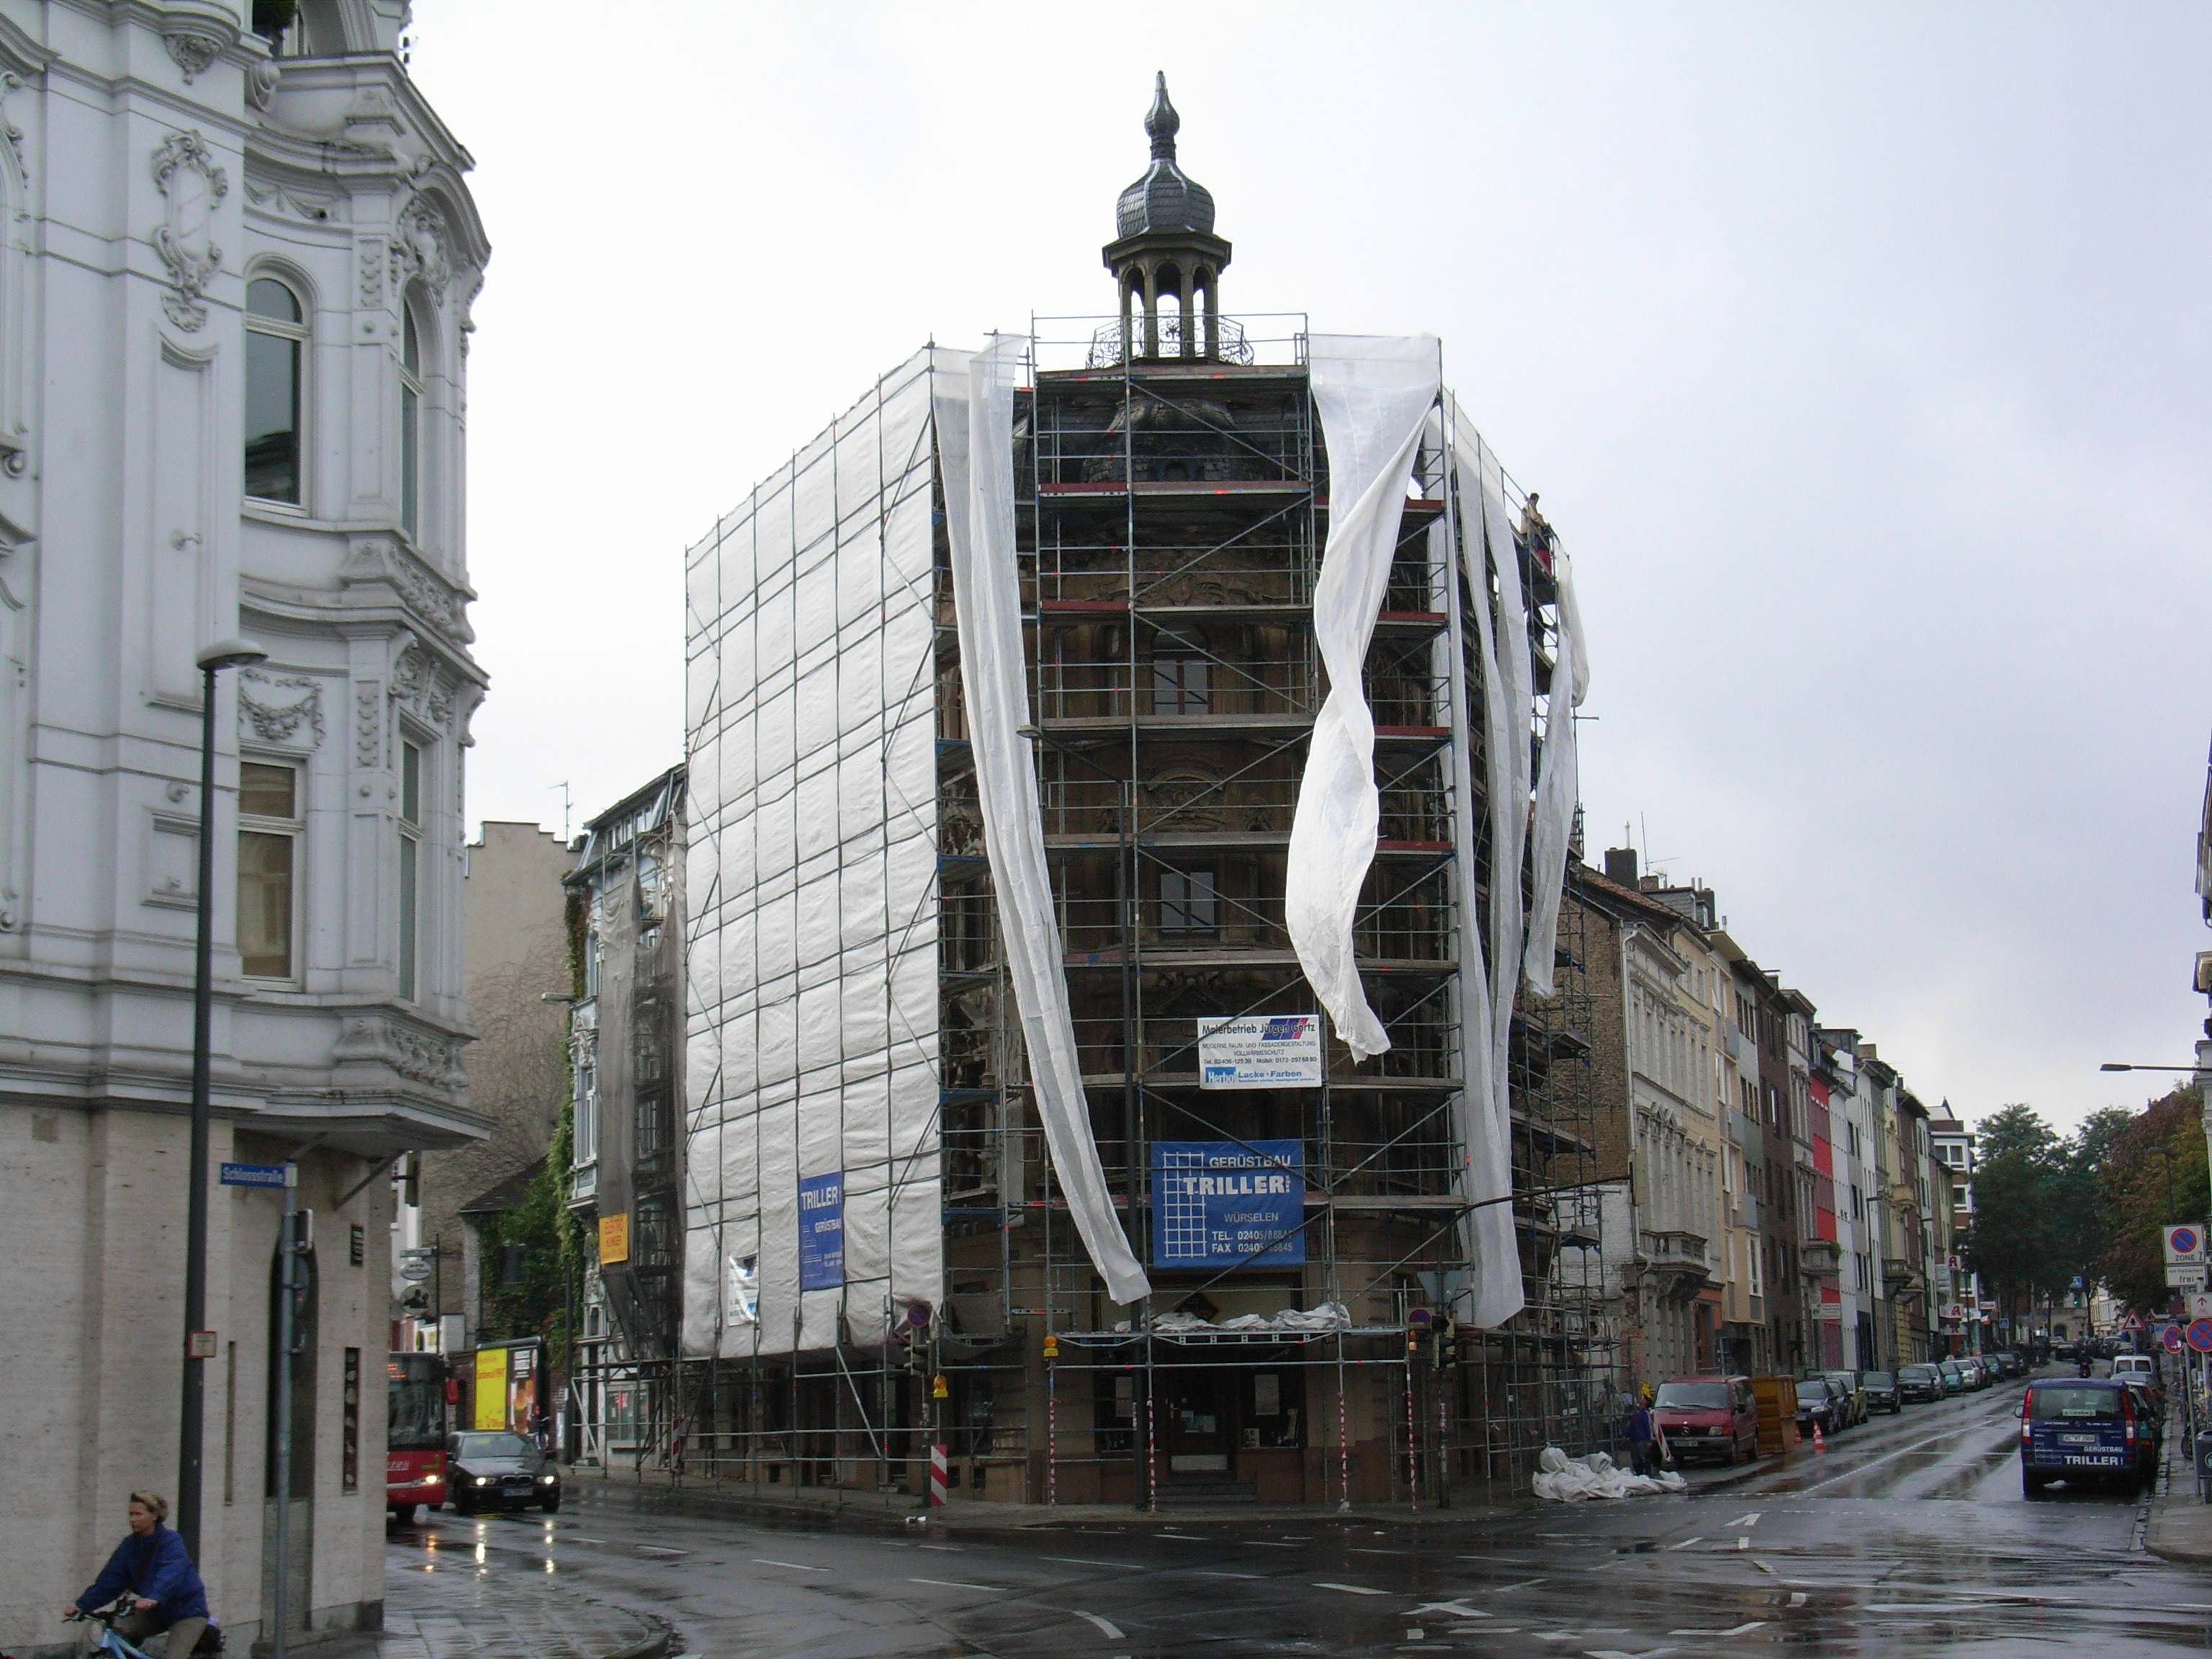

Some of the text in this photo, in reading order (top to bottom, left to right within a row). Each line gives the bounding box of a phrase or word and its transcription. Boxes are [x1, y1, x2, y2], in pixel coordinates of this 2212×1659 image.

[1260, 1022, 1289, 1036] Jürgen
[1292, 1021, 1316, 1032] Görtz
[1209, 1154, 1291, 1167] GERÜSTBAU
[1183, 1175, 1285, 1195] TRILLER
[801, 1185, 838, 1210] TRILLER
[1223, 1211, 1279, 1223] WÜRSELEN
[1211, 1231, 1233, 1241] TEL.
[1212, 1244, 1231, 1253] FAX
[2064, 1455, 2118, 1465] TRILLER
